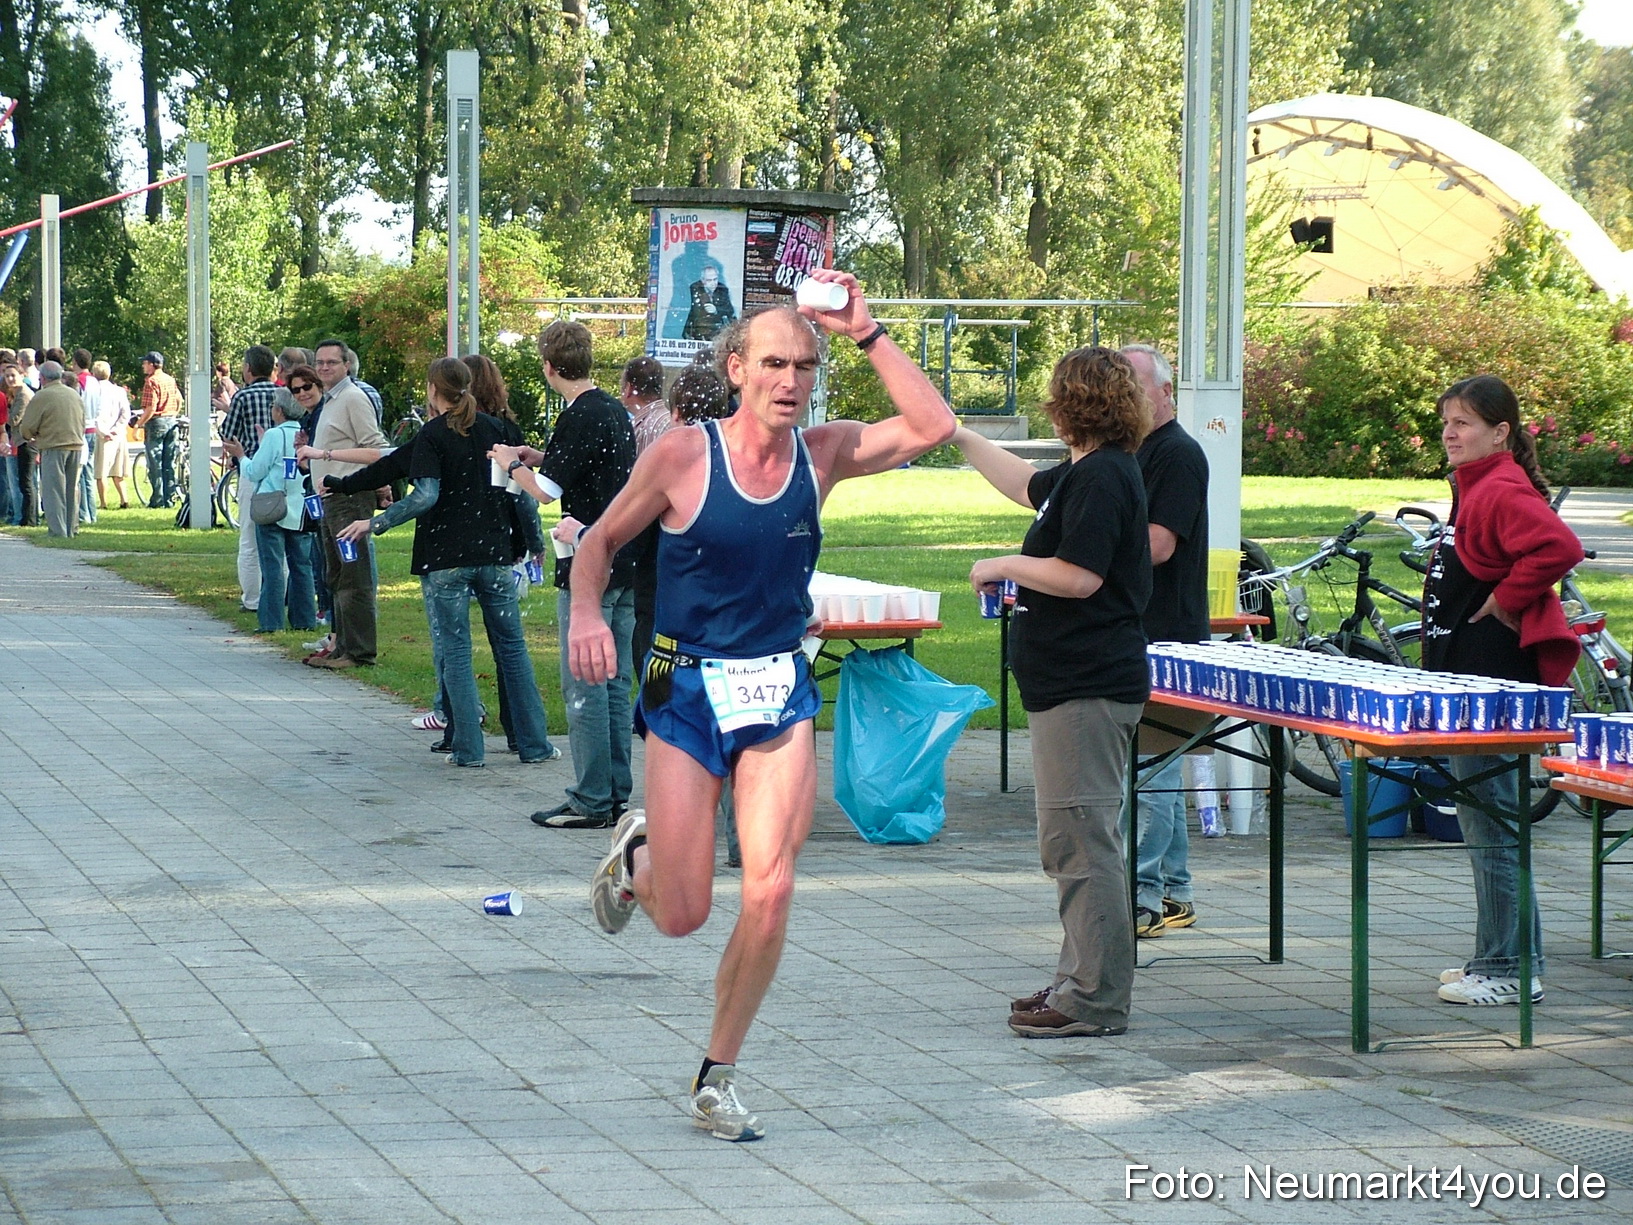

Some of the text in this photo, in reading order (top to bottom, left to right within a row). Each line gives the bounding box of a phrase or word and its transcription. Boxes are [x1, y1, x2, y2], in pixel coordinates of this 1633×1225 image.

[671, 213, 698, 224] Bruno
[664, 221, 718, 251] Jonas
[688, 341, 696, 349] 20
[737, 684, 791, 705] 3473
